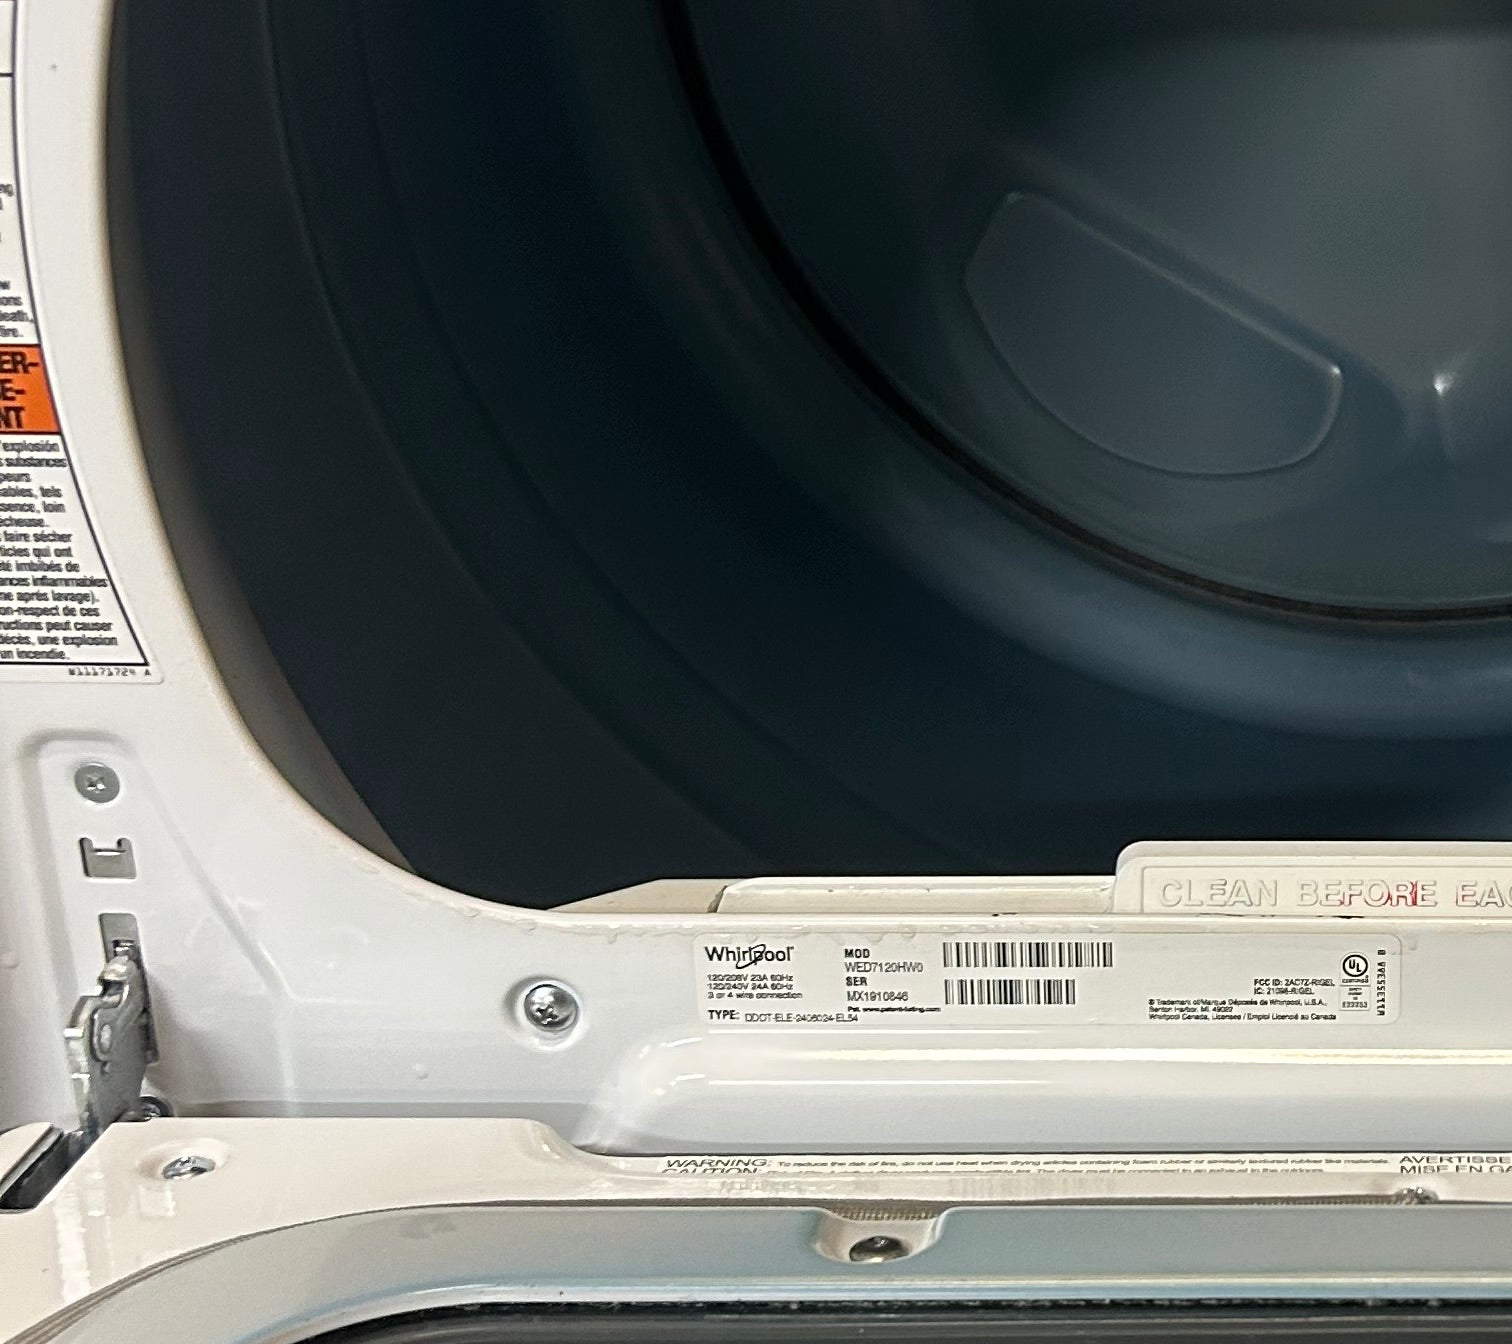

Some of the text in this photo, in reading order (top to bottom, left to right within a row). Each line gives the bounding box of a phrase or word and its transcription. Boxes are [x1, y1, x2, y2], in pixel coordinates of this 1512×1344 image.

[1160, 880, 1279, 908] CLEAN
[1299, 880, 1437, 908] BEFORE
[704, 943, 794, 970] Whirlpool
[844, 948, 870, 958] MOD
[845, 976, 867, 986] SER
[1253, 978, 1270, 986] FCC
[708, 1009, 739, 1019] TYPE:
